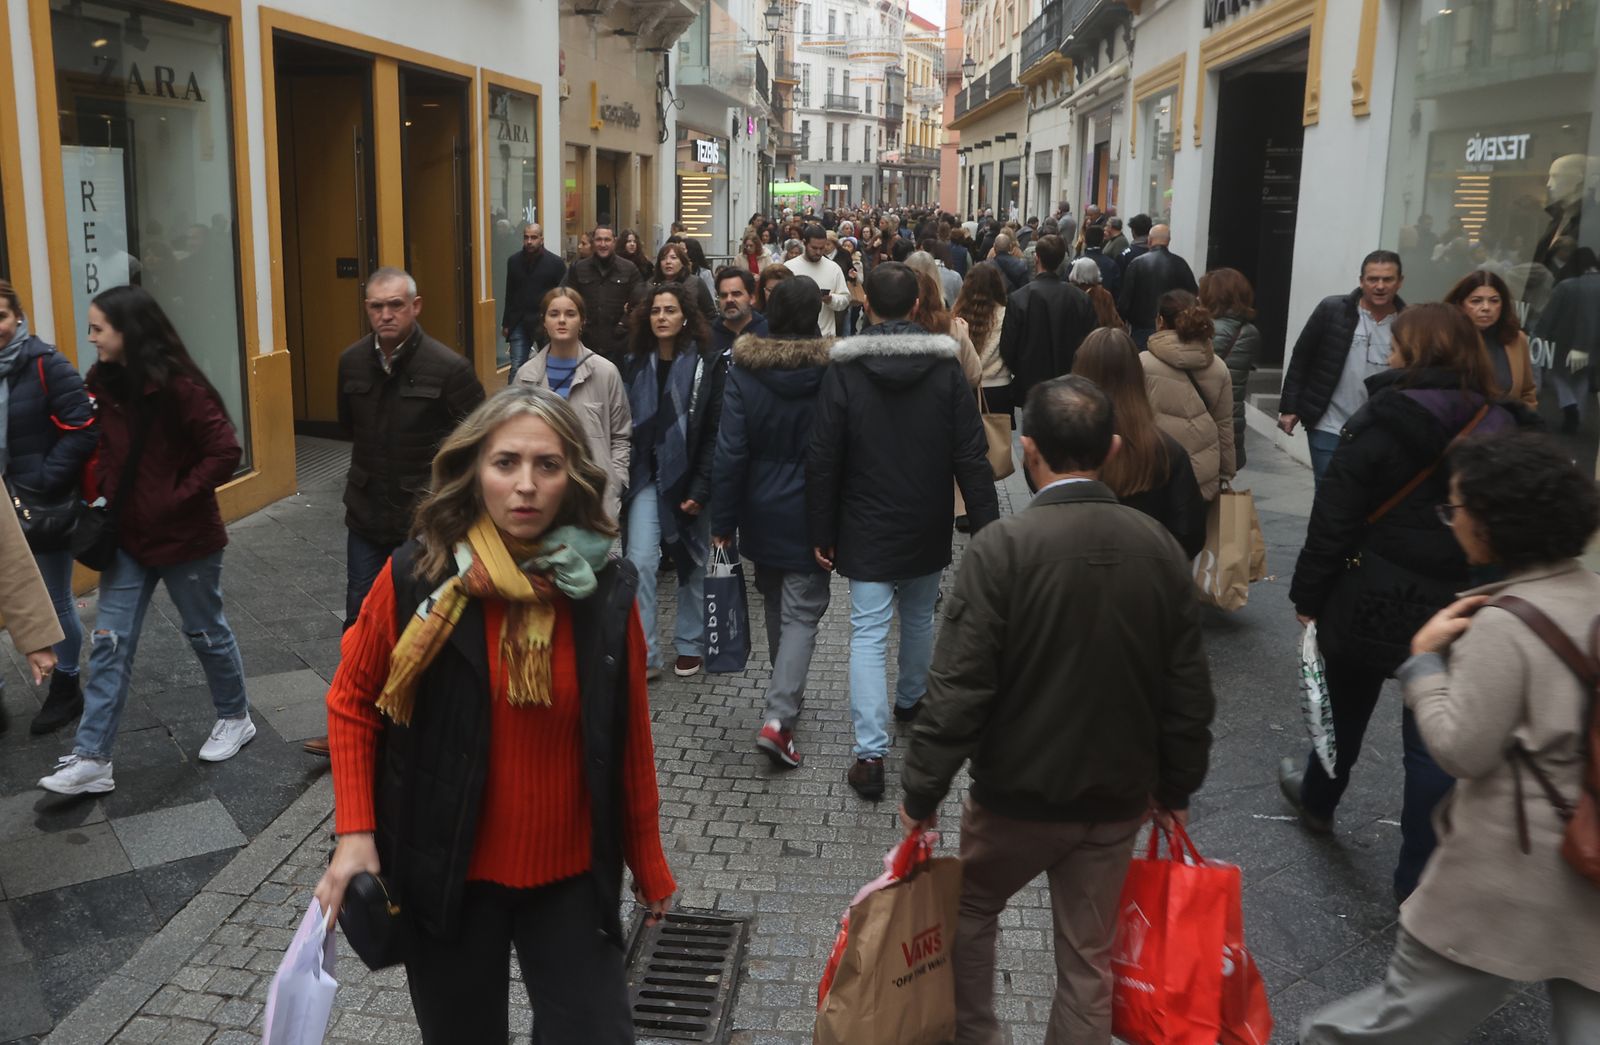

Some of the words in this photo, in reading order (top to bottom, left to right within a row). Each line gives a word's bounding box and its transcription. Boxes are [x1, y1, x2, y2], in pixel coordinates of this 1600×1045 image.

[93, 56, 206, 102] ZARA
[497, 121, 529, 143] ZARA
[901, 923, 942, 968] VANS
